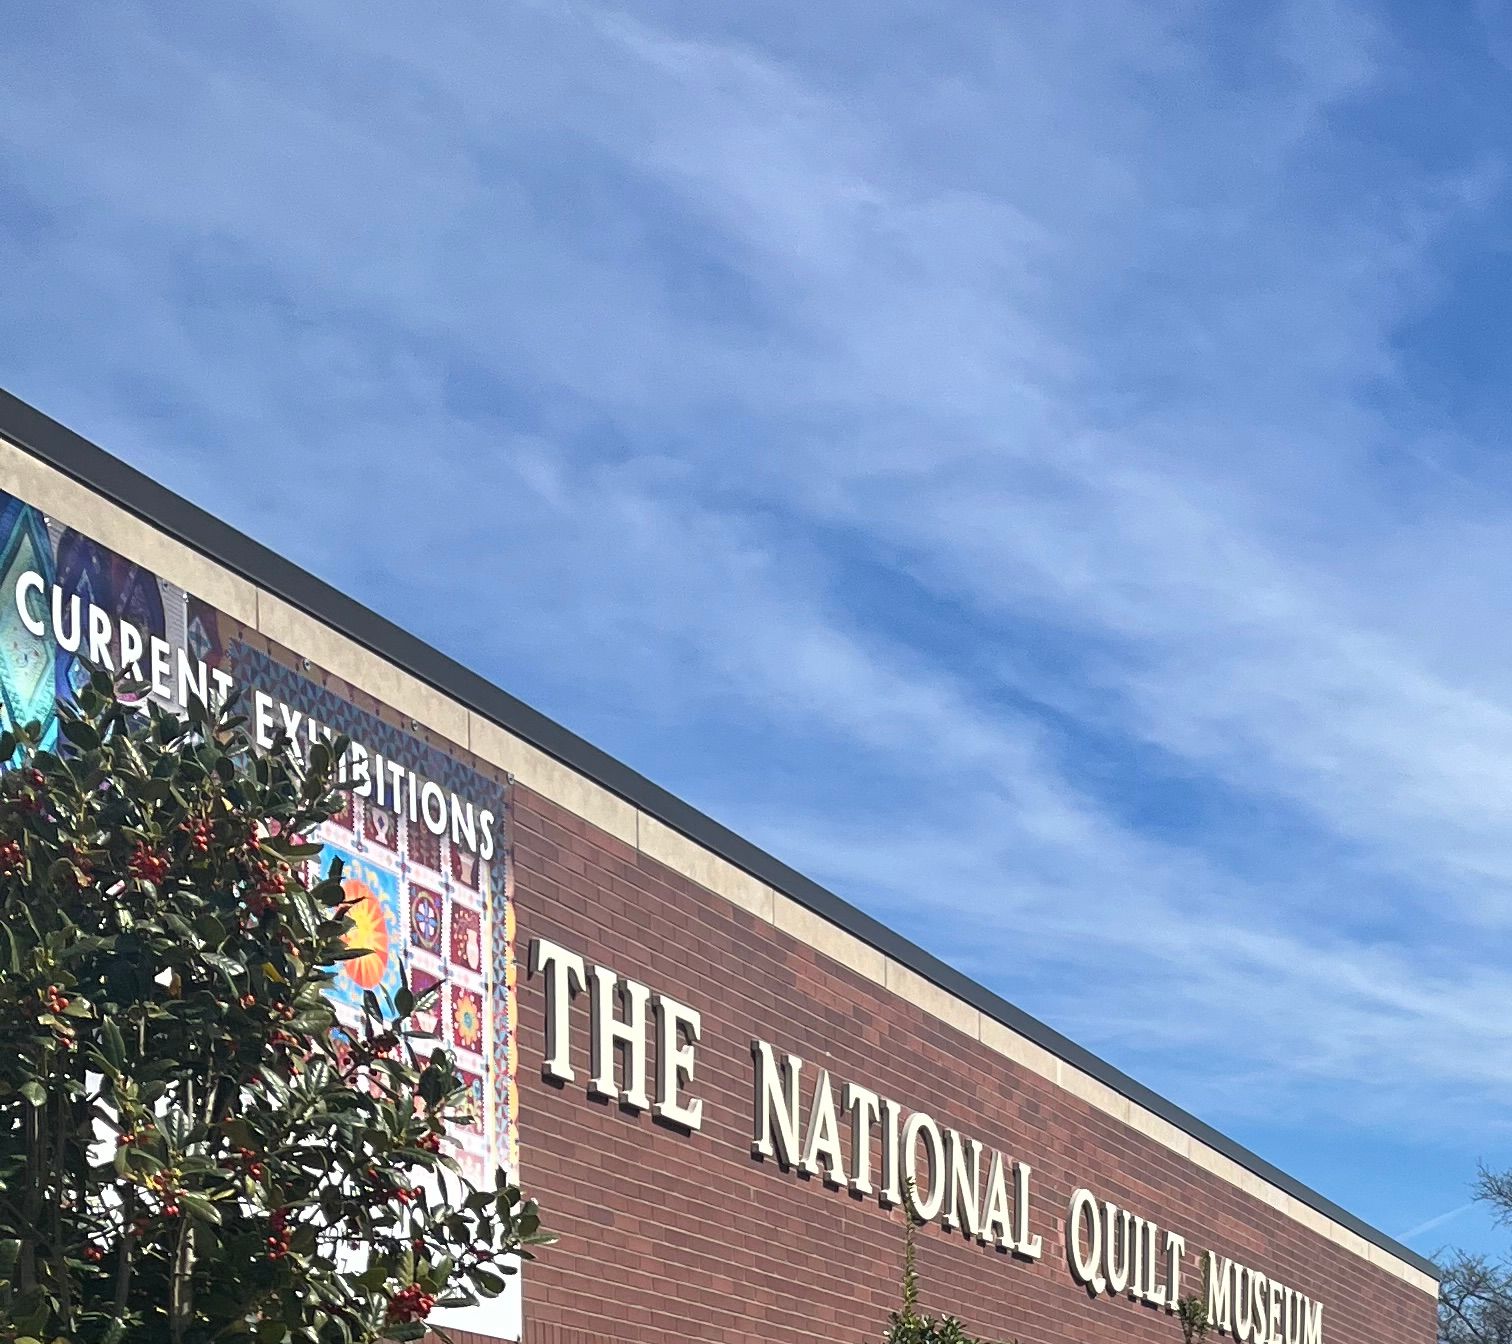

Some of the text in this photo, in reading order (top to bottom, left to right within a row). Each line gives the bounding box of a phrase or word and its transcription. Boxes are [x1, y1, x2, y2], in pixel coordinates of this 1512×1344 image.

[15, 570, 233, 724] CURRENT
[532, 937, 703, 1131] THE
[752, 1040, 1042, 1259] NATIONAL
[1067, 1188, 1185, 1311] QUILT
